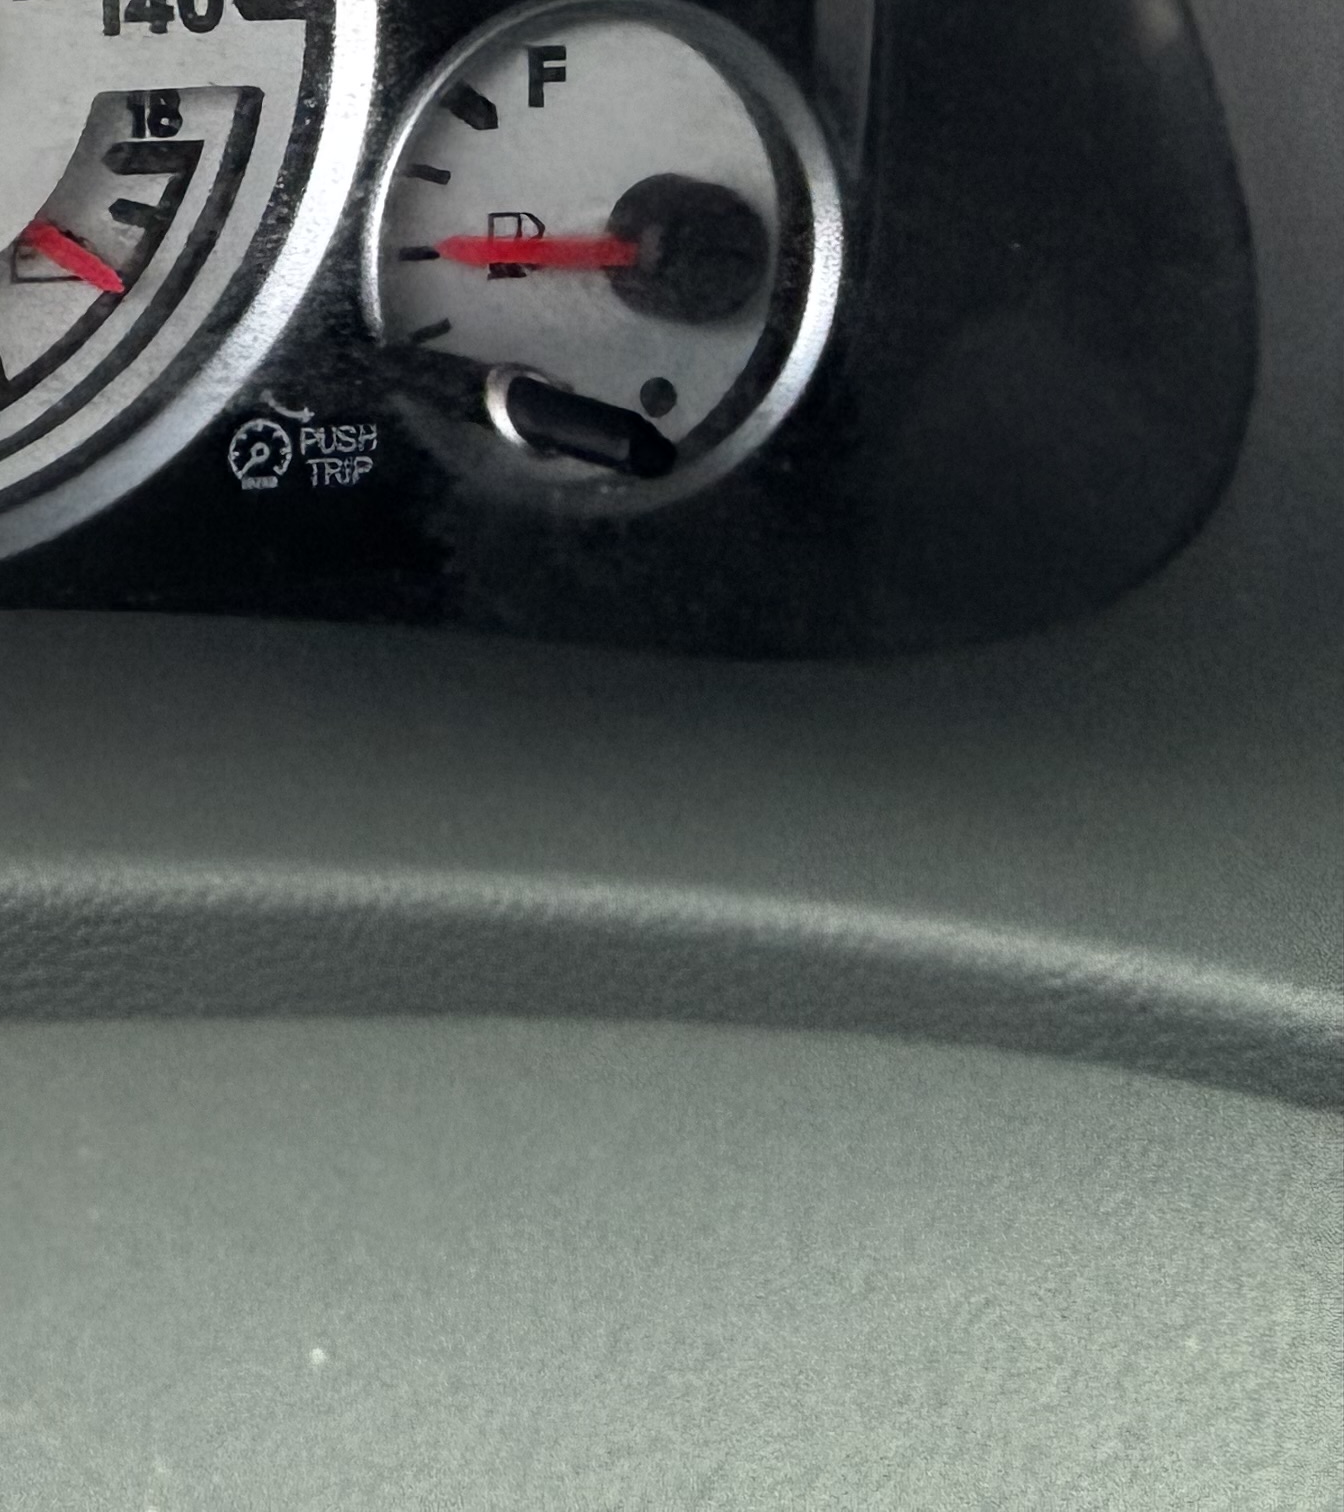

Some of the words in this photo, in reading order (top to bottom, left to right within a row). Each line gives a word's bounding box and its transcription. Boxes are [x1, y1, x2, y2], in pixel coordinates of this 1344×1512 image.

[526, 44, 567, 108] F
[299, 423, 378, 456] PUSH
[306, 455, 374, 488] TRIP
